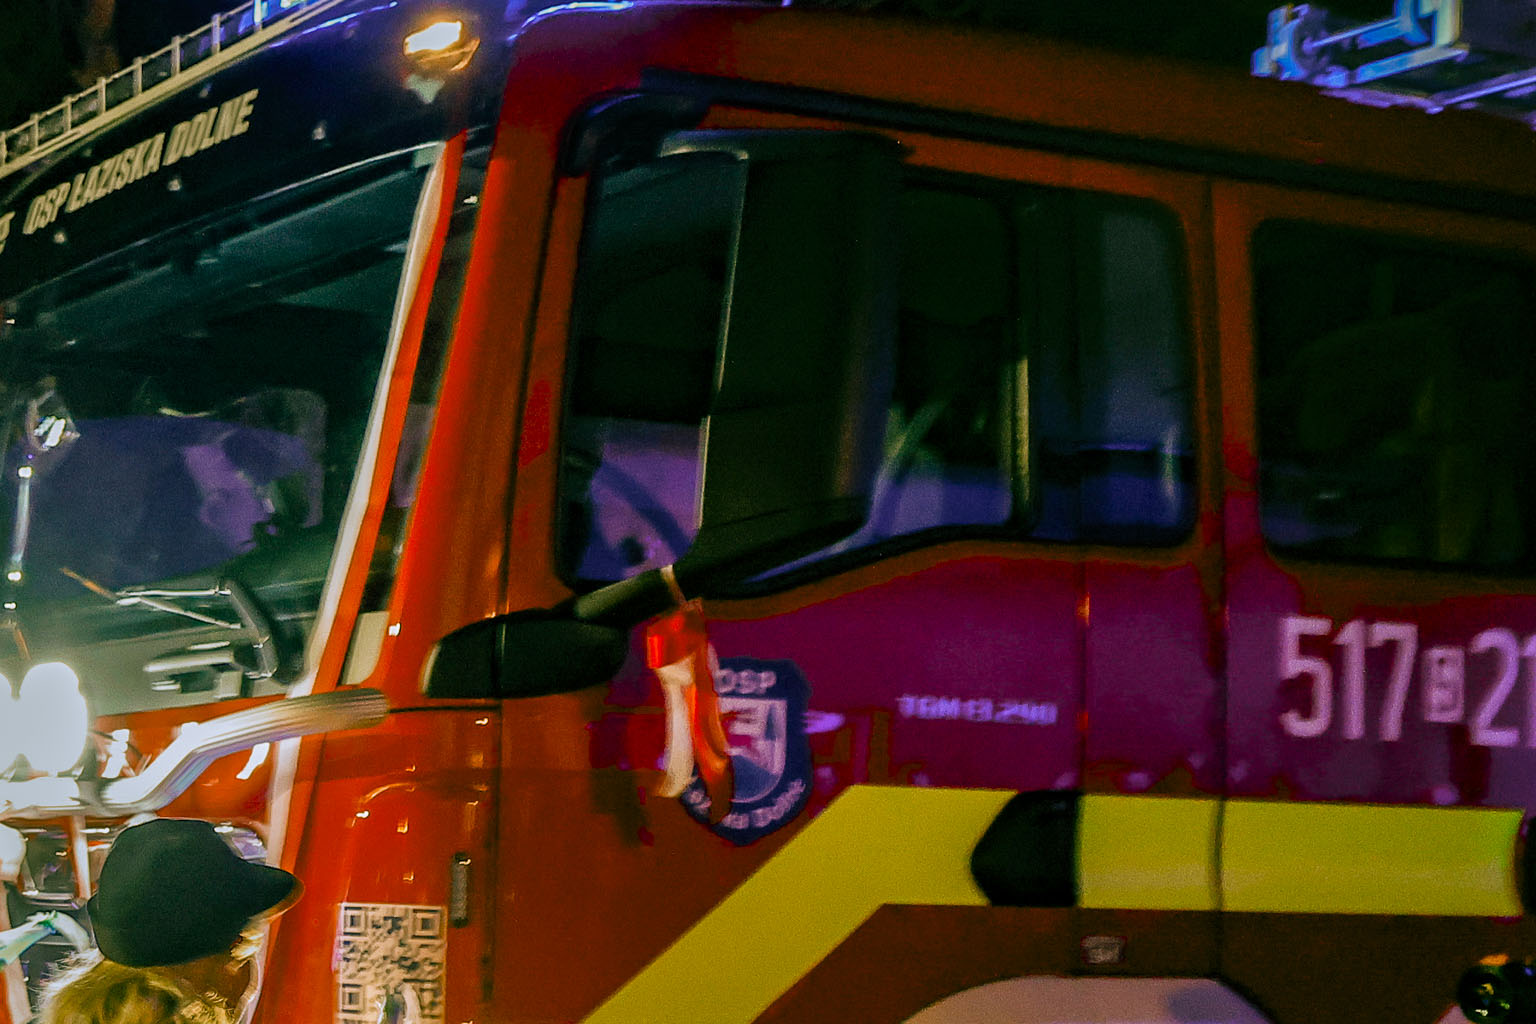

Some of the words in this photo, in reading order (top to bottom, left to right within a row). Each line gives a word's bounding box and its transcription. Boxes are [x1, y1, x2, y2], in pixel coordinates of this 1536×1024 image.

[23, 182, 71, 235] OSP
[163, 89, 260, 167] DOLNE
[1278, 614, 1419, 743] 517
